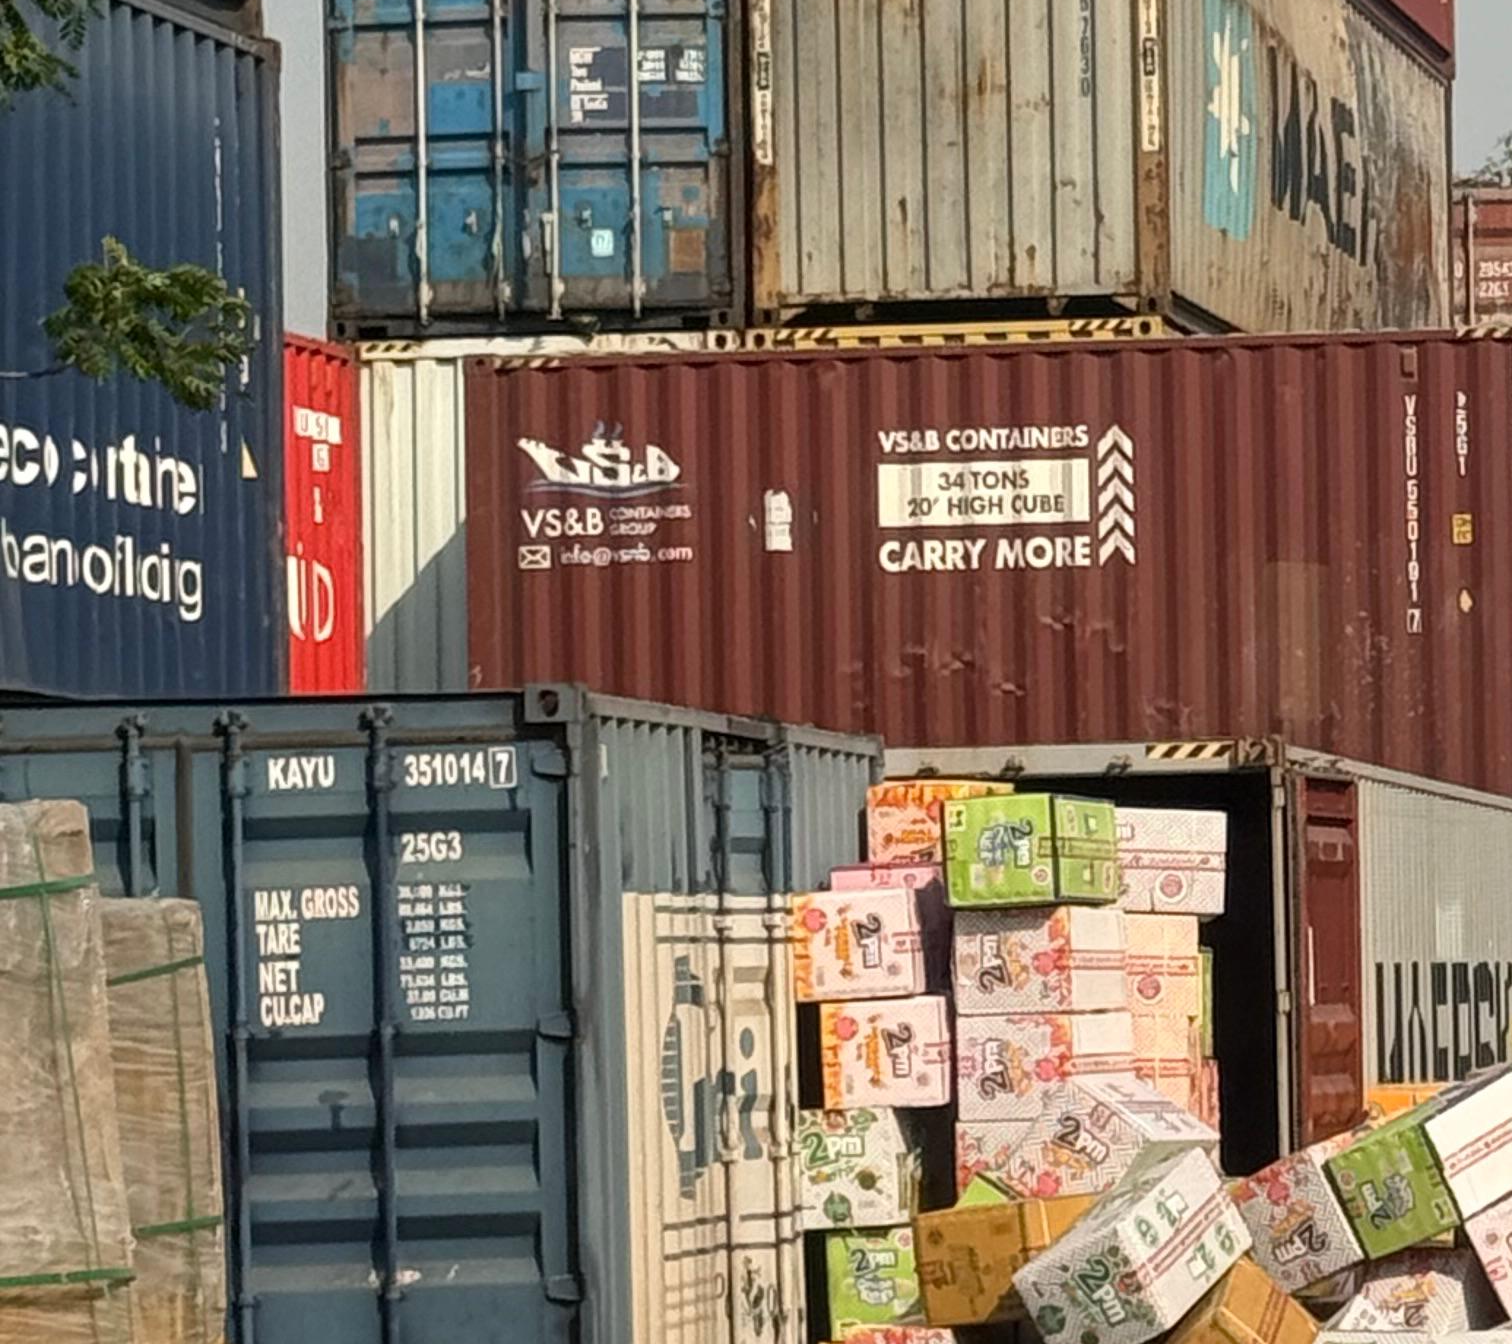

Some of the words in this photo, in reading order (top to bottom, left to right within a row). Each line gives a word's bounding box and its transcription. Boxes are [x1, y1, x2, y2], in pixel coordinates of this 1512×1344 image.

[878, 429, 940, 454] VS&B
[945, 424, 1089, 452] CONTAINERS
[937, 471, 966, 492] 34
[970, 469, 1030, 490] TONS
[521, 508, 604, 539] VS&B
[608, 504, 692, 521] CONTAINERS
[947, 496, 1004, 516] HIGH
[1011, 493, 1065, 514] CUBE
[608, 521, 657, 536] GROUP
[878, 538, 987, 573] CARRY
[994, 534, 1092, 571] MORE
[267, 756, 335, 790] KAYU
[404, 751, 486, 787] 351014
[401, 830, 462, 863] 25G3
[255, 891, 298, 921] MAX.
[301, 885, 360, 919] GROSS
[256, 923, 301, 956] TARE
[259, 961, 300, 994] NET
[800, 1132, 864, 1173] 2pm
[1053, 1113, 1112, 1164] 2pm
[1072, 1258, 1130, 1327] 2pm
